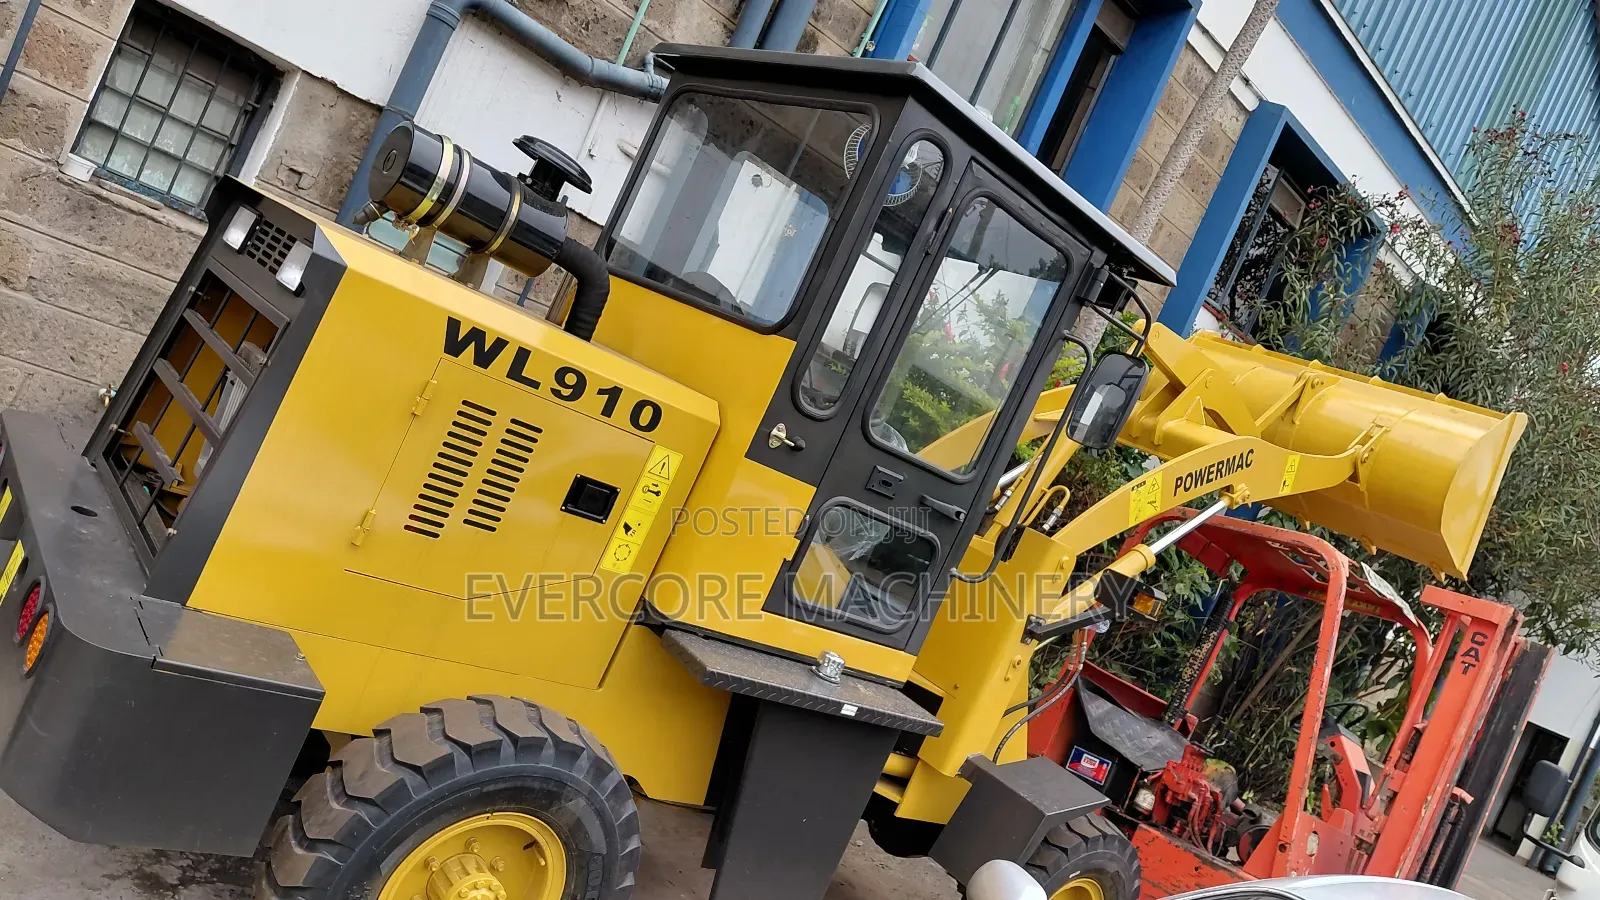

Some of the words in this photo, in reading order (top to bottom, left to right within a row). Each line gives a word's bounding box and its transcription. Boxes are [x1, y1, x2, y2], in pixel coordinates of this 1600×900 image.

[443, 315, 663, 433] WL910
[1173, 448, 1255, 497] POWERMAC
[1460, 631, 1489, 676] CAT
